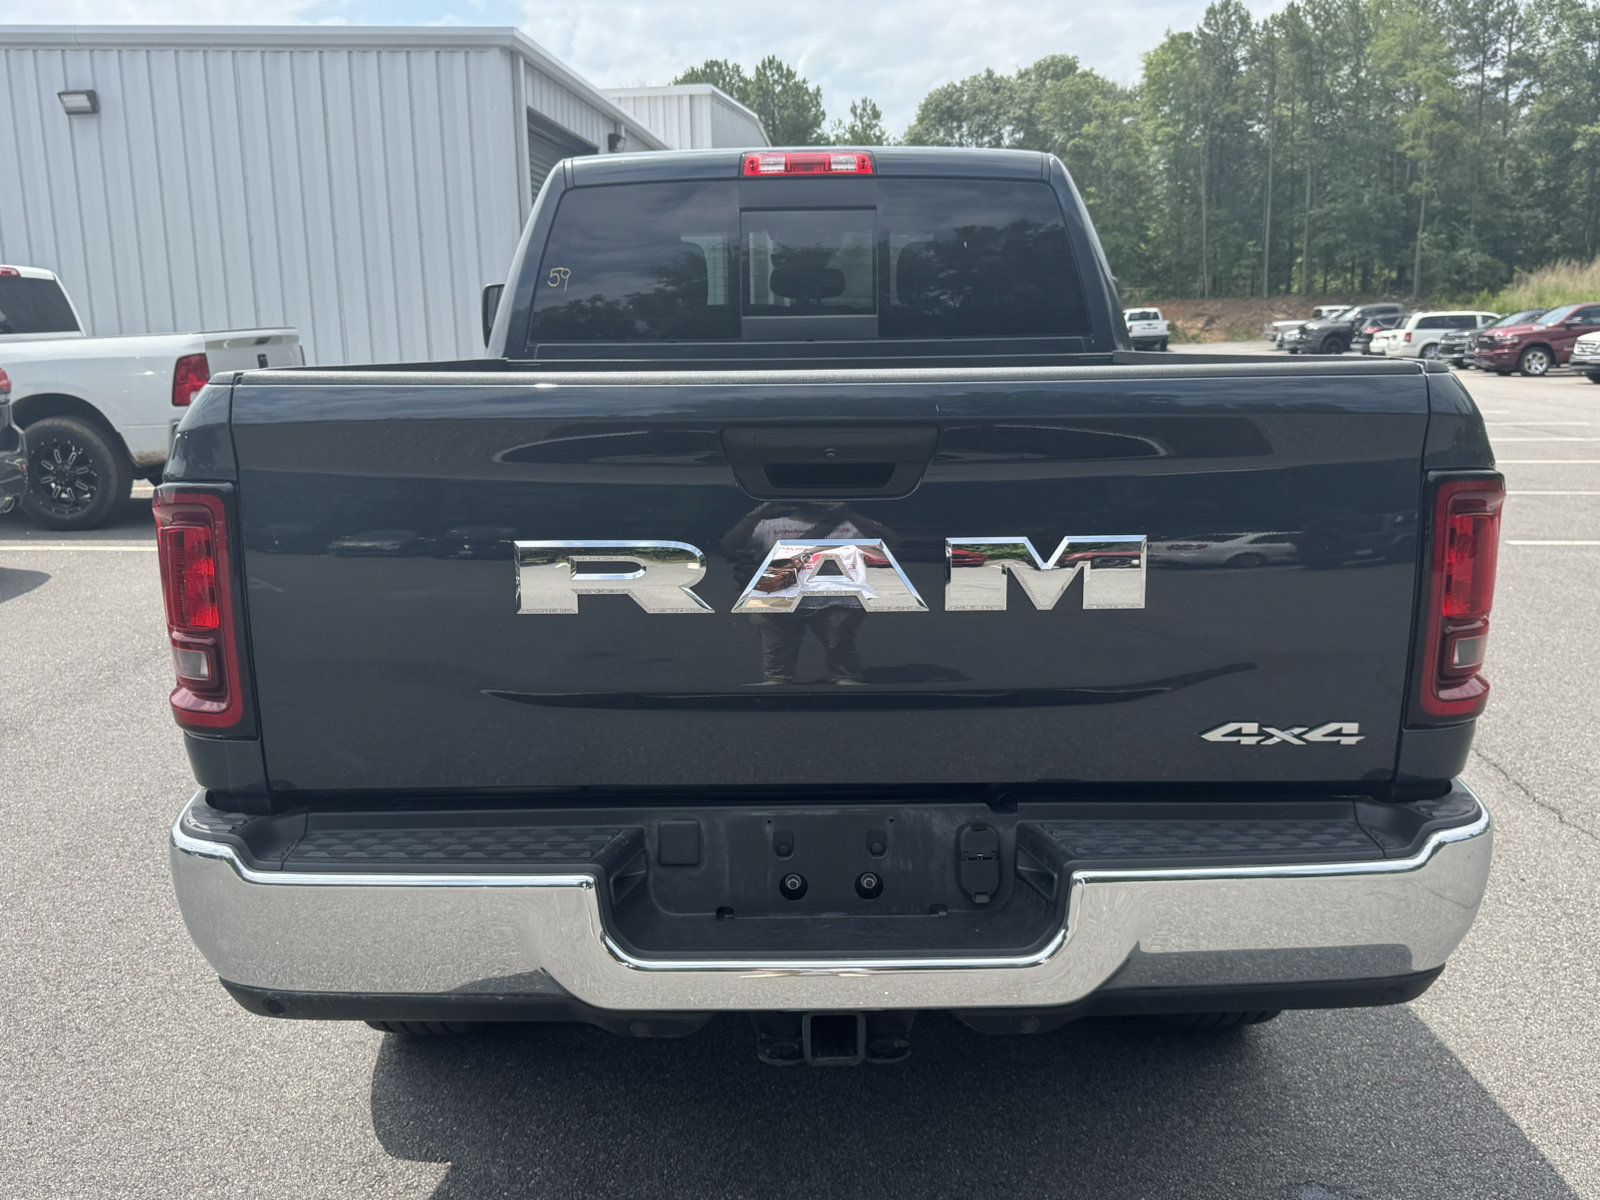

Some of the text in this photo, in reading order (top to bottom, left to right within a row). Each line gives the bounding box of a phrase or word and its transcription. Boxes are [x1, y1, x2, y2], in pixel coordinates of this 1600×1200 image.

[547, 267, 571, 292] 59
[514, 535, 1148, 615] RAM
[1200, 721, 1366, 746] 4x4
